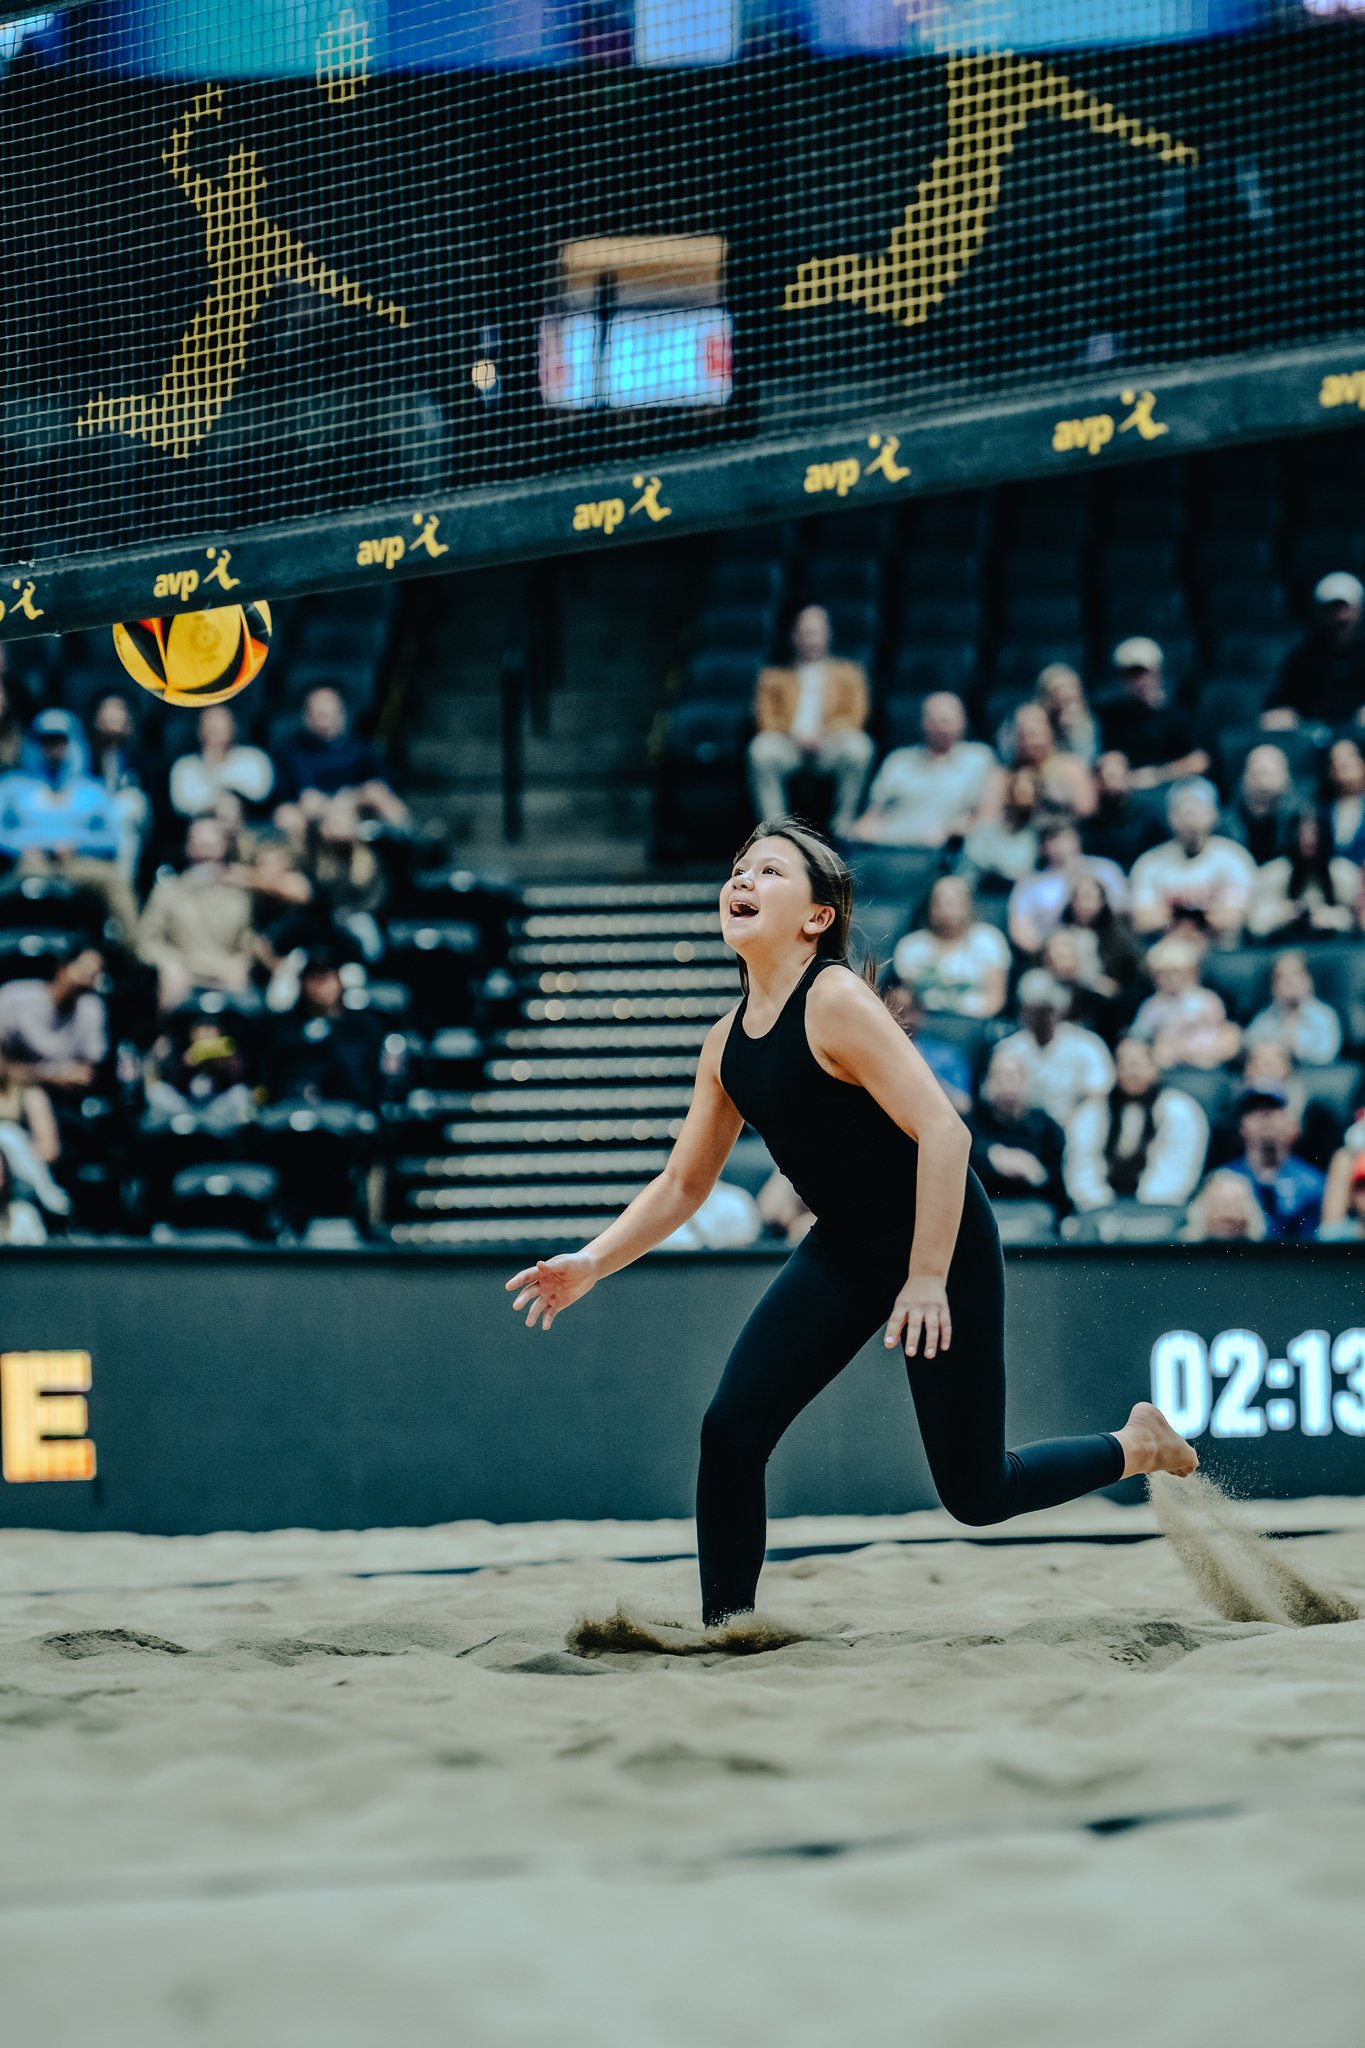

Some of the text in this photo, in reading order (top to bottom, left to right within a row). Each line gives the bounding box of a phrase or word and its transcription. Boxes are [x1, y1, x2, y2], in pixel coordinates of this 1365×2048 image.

[1053, 415, 1114, 454] avp
[804, 458, 860, 496] avp
[573, 498, 625, 534] avp
[357, 535, 405, 569] avp
[153, 569, 199, 601] avp
[1150, 1328, 1365, 1439] 02:13
[0, 1350, 97, 1483] E
